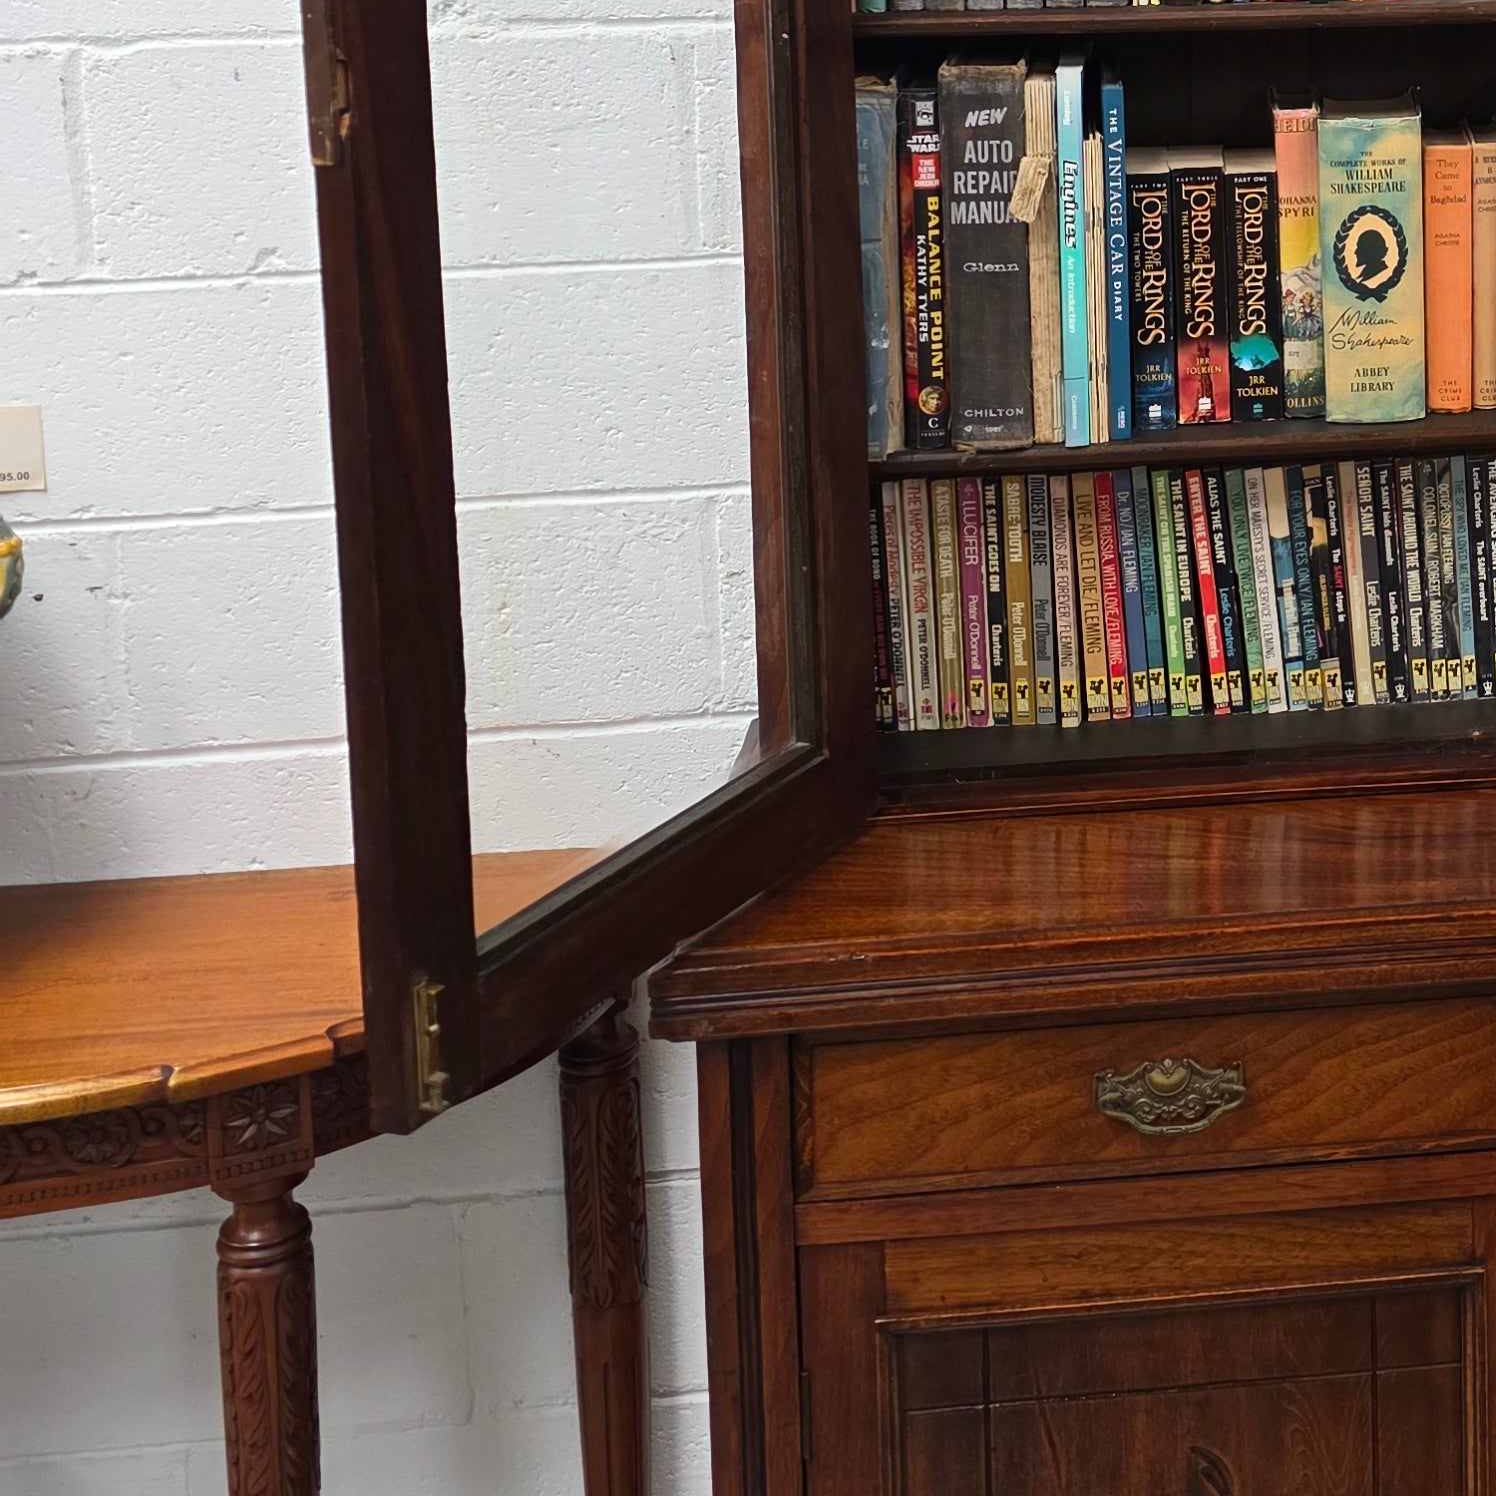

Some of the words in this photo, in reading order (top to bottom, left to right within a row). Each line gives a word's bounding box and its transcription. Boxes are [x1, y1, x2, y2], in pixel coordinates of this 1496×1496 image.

[965, 108, 1007, 128] NEW
[1109, 109, 1118, 133] THE
[964, 140, 1013, 163] AUTO
[1330, 158, 1368, 167] COMPLETE
[1398, 158, 1406, 166] OF
[1436, 159, 1460, 168] They
[1108, 139, 1123, 228] VINTAGE
[1345, 168, 1393, 181] WILLIAM
[1435, 171, 1460, 180] Came
[1331, 181, 1406, 194] SHAKESPEARE
[1430, 194, 1466, 205] Baghdad
[951, 201, 1025, 225] MANUA
[1062, 160, 1080, 249] Engines
[917, 234, 927, 287] KATHY
[927, 196, 941, 302] BALANCE
[1110, 234, 1125, 274] CAR
[963, 262, 1019, 272] Glenn
[1067, 256, 1075, 277] An
[1067, 279, 1076, 334] Introduction
[1113, 282, 1123, 321] DIARY
[1240, 262, 1268, 336] RINGS
[918, 293, 929, 343] TYERS
[1329, 306, 1398, 333] William
[930, 311, 944, 380] POINT
[1332, 332, 1414, 351] Shakespeare
[1249, 376, 1265, 385] JRR
[1354, 367, 1390, 377] ABBEY
[1237, 387, 1278, 397] TOLKIEN
[1350, 381, 1395, 393] LIBRARY
[964, 407, 1024, 418] CHILTON
[907, 486, 923, 506] THE
[985, 484, 997, 506] THE
[1030, 477, 1045, 526] MODESTY
[986, 508, 998, 543] SAINT
[1006, 483, 1022, 562] SABRE-TOOTH
[909, 508, 927, 574] IMPOSSIBLE
[1032, 531, 1047, 566] BLAISE
[987, 544, 999, 572] GOES
[913, 576, 929, 613] VIRGIN
[989, 574, 1000, 592] ON
